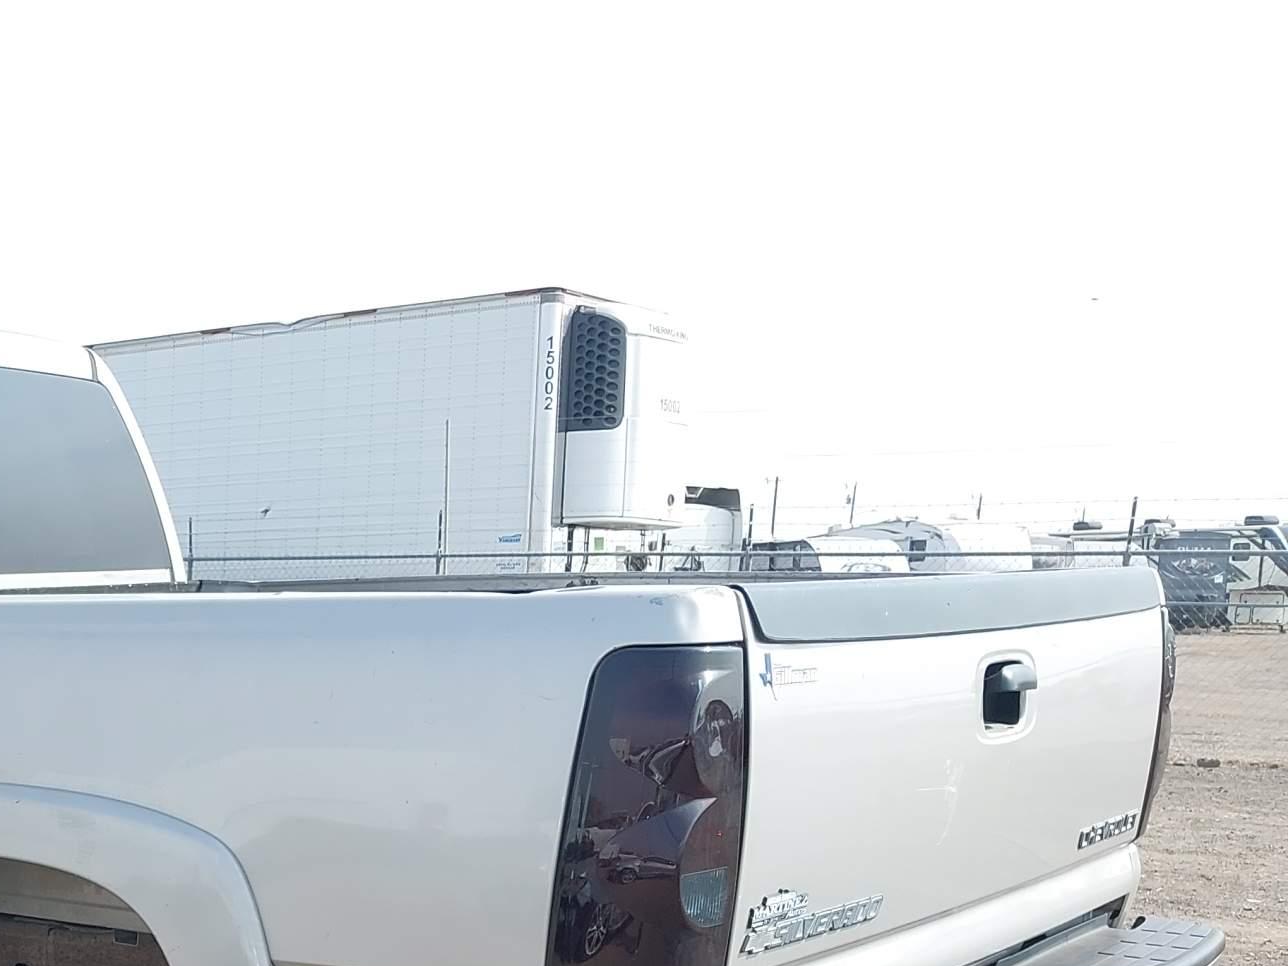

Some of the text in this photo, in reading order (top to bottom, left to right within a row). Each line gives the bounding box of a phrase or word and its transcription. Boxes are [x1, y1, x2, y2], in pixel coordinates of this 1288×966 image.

[543, 335, 555, 411] 15002
[659, 398, 681, 415] 15002
[1077, 809, 1139, 850] CHEVROLET
[753, 895, 809, 921] MARTINEZ
[773, 893, 883, 943] SILVERADO
